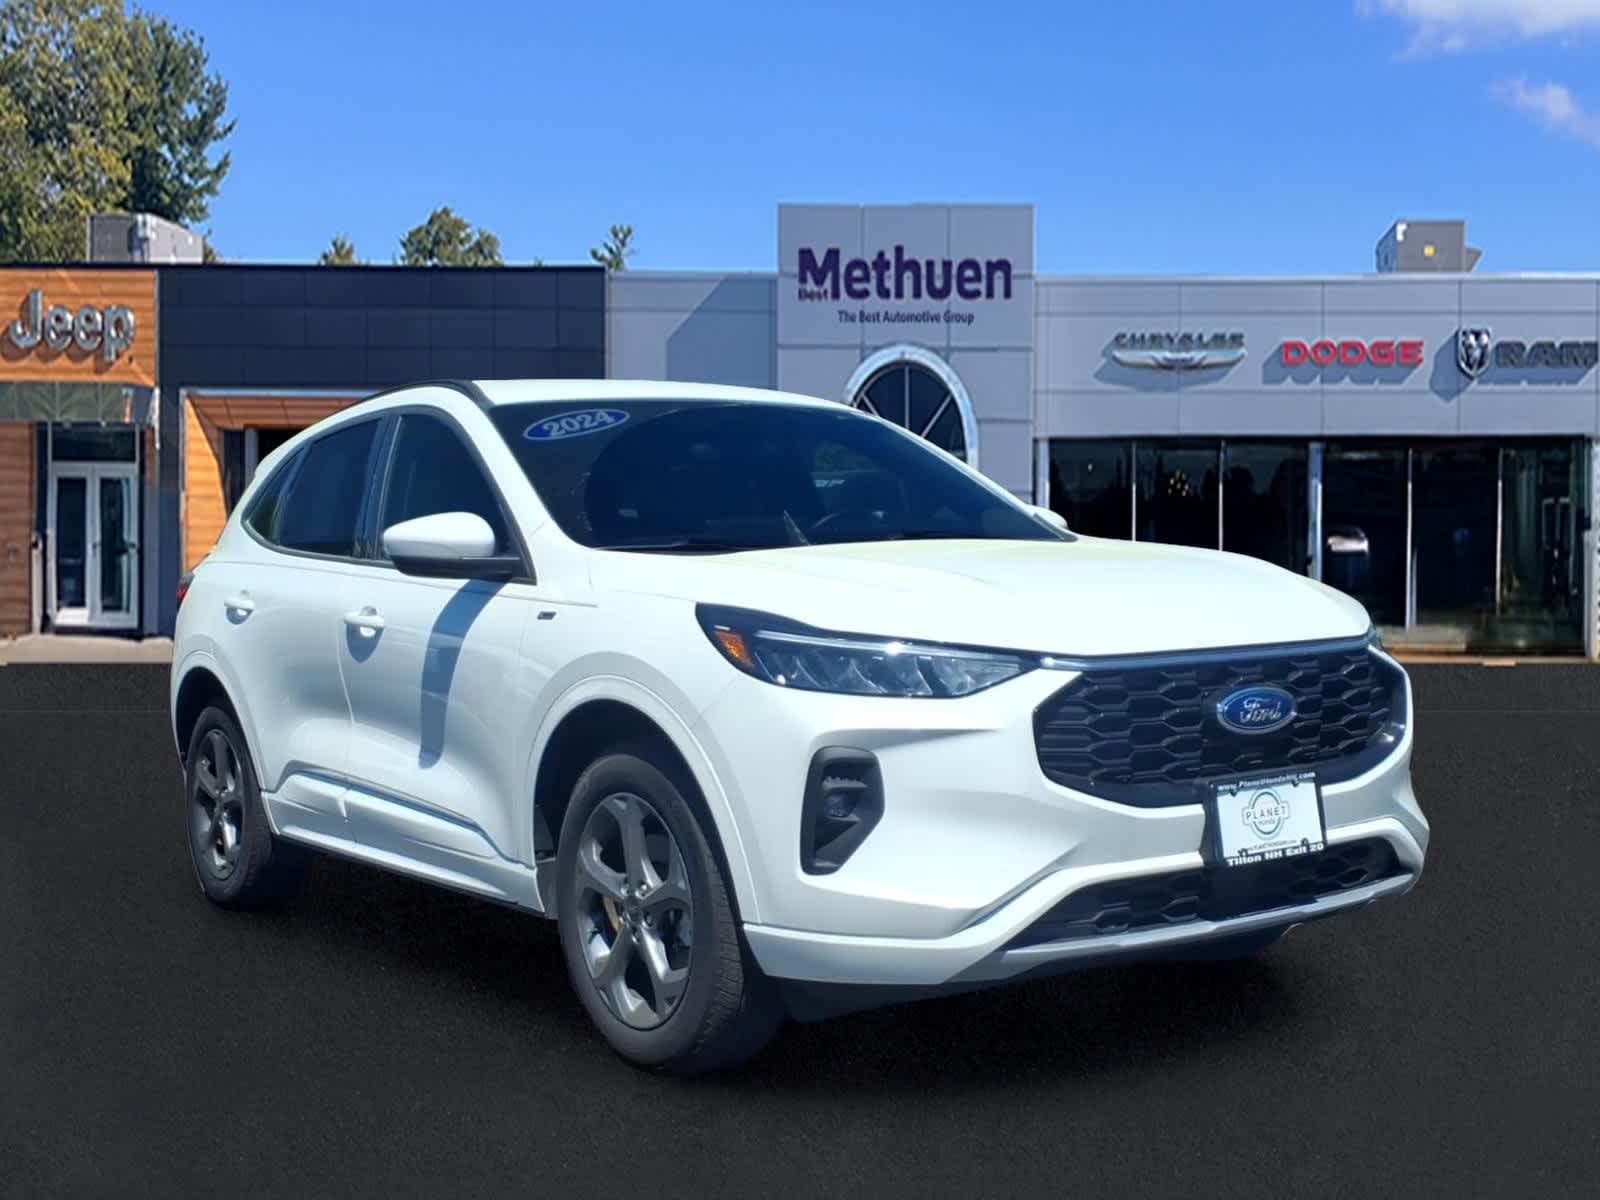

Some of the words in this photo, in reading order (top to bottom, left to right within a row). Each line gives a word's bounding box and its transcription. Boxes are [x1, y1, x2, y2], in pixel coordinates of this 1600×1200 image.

[798, 245, 1013, 300] Methuen
[9, 288, 135, 362] Jeep
[837, 310, 857, 323] The
[859, 310, 881, 324] Best
[882, 309, 941, 324] Automotive
[943, 309, 975, 326] Group
[1114, 332, 1245, 349] CHRYSLER
[1281, 339, 1425, 366] DODGE
[1495, 341, 1599, 369] RAM
[543, 410, 614, 437] 2024
[1239, 697, 1282, 724] Ford
[1246, 806, 1287, 820] PLANET
[1264, 850, 1284, 861] NH
[1285, 845, 1308, 857] Exit
